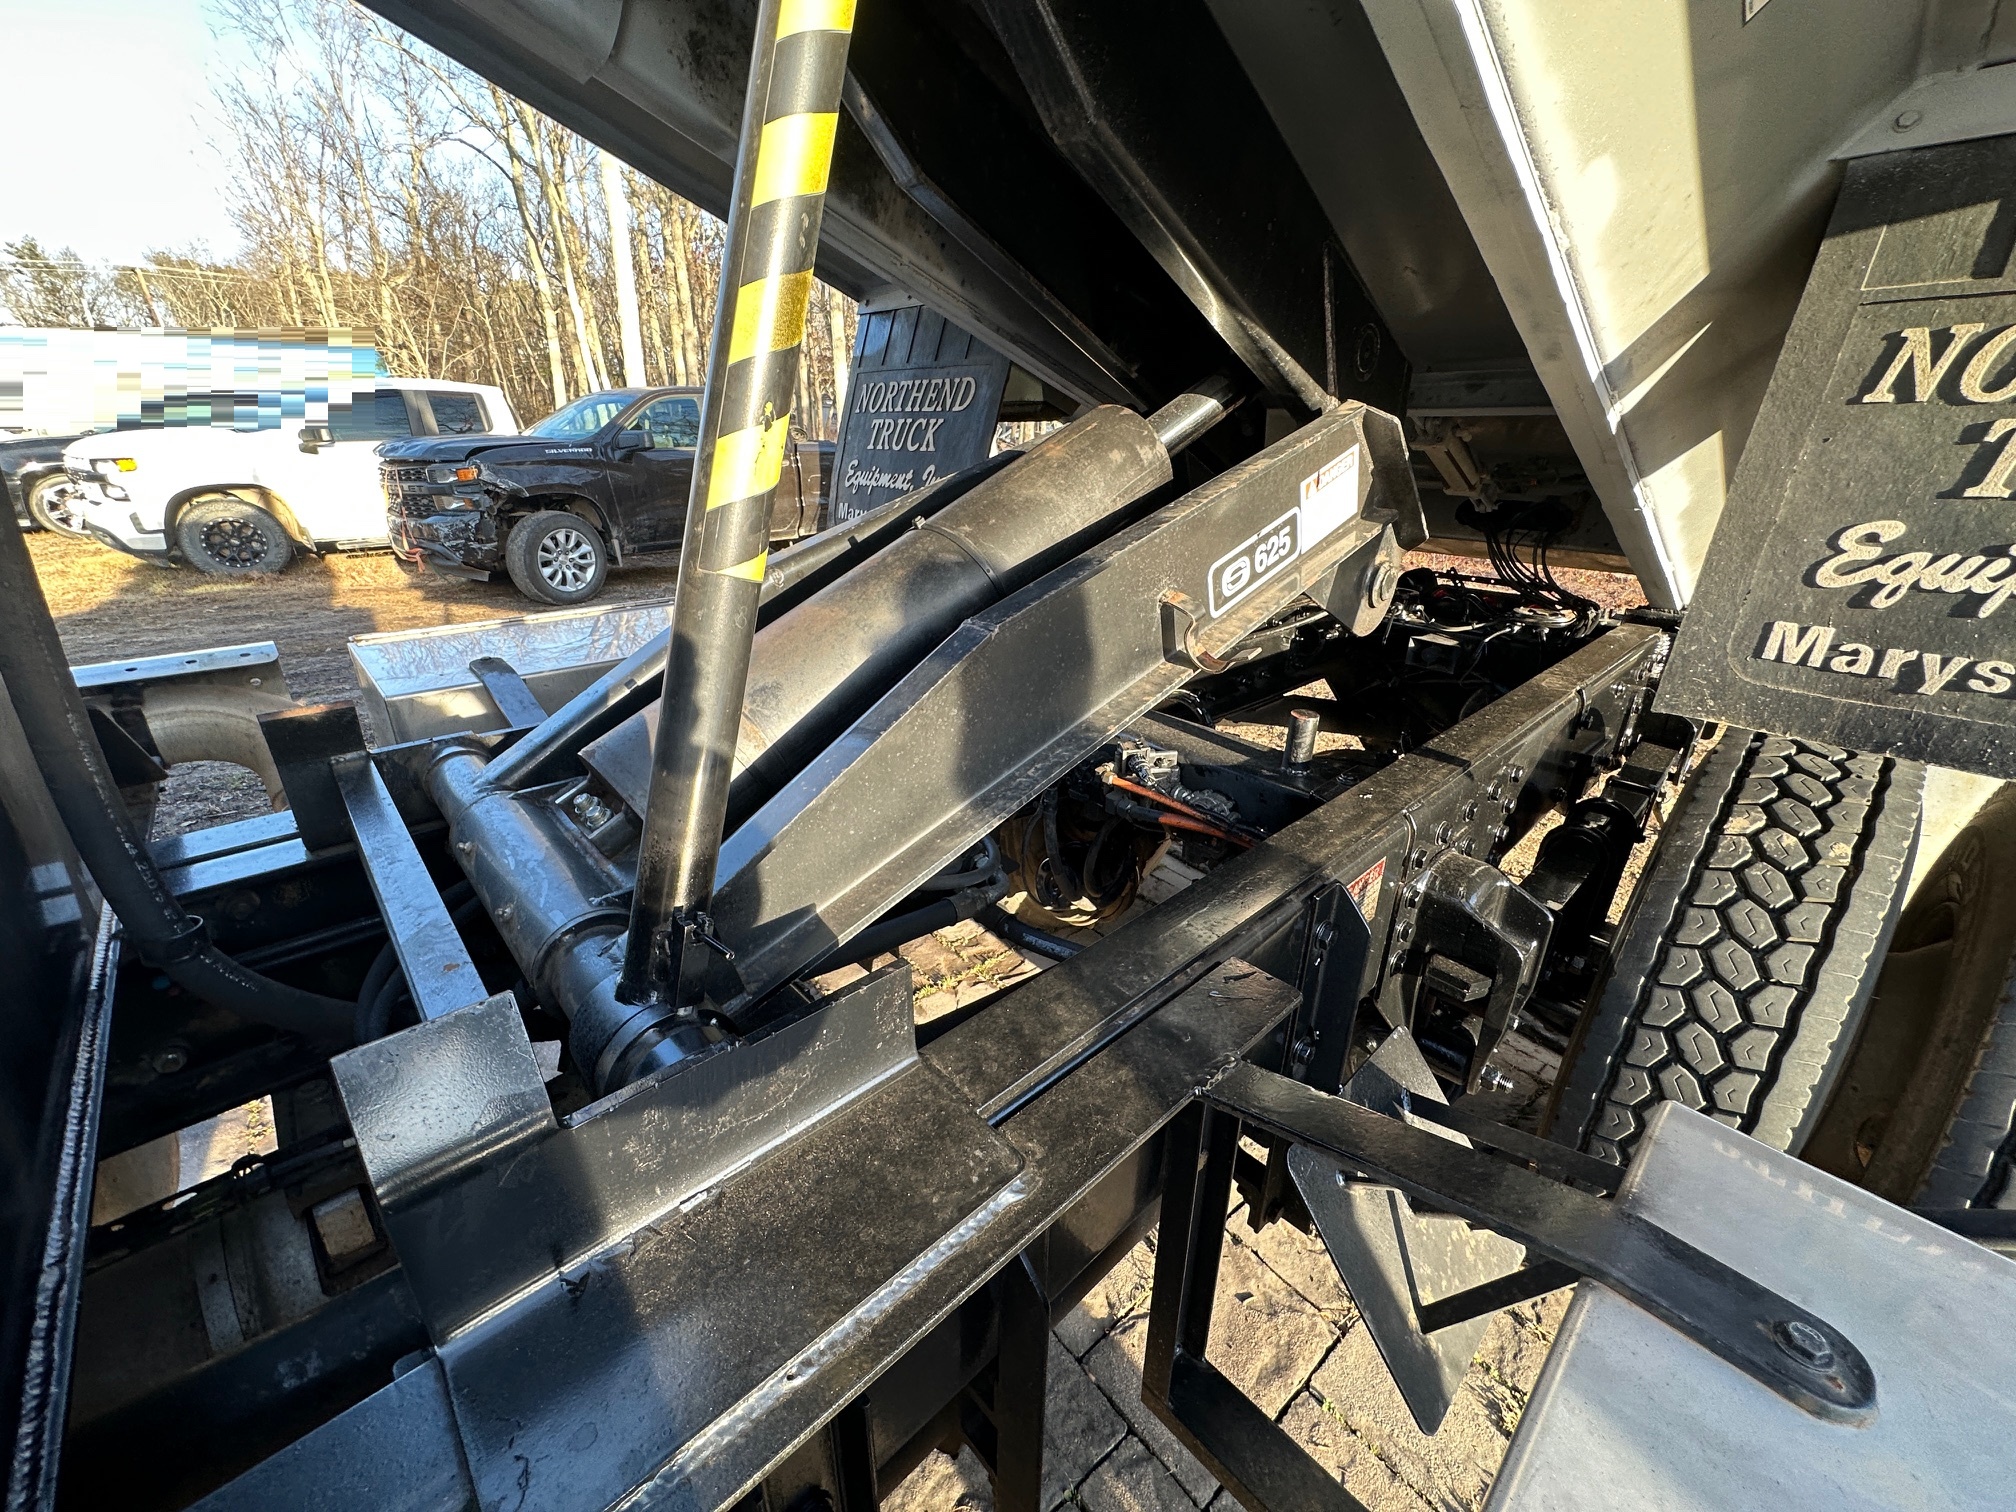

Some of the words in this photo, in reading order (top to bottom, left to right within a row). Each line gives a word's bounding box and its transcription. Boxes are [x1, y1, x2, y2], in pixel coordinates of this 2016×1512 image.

[855, 377, 976, 414] NORTHEND
[867, 418, 945, 452] TRUCK
[844, 459, 914, 495] Equipment,
[1254, 525, 1290, 573] 625
[1761, 620, 2016, 695] Marys
